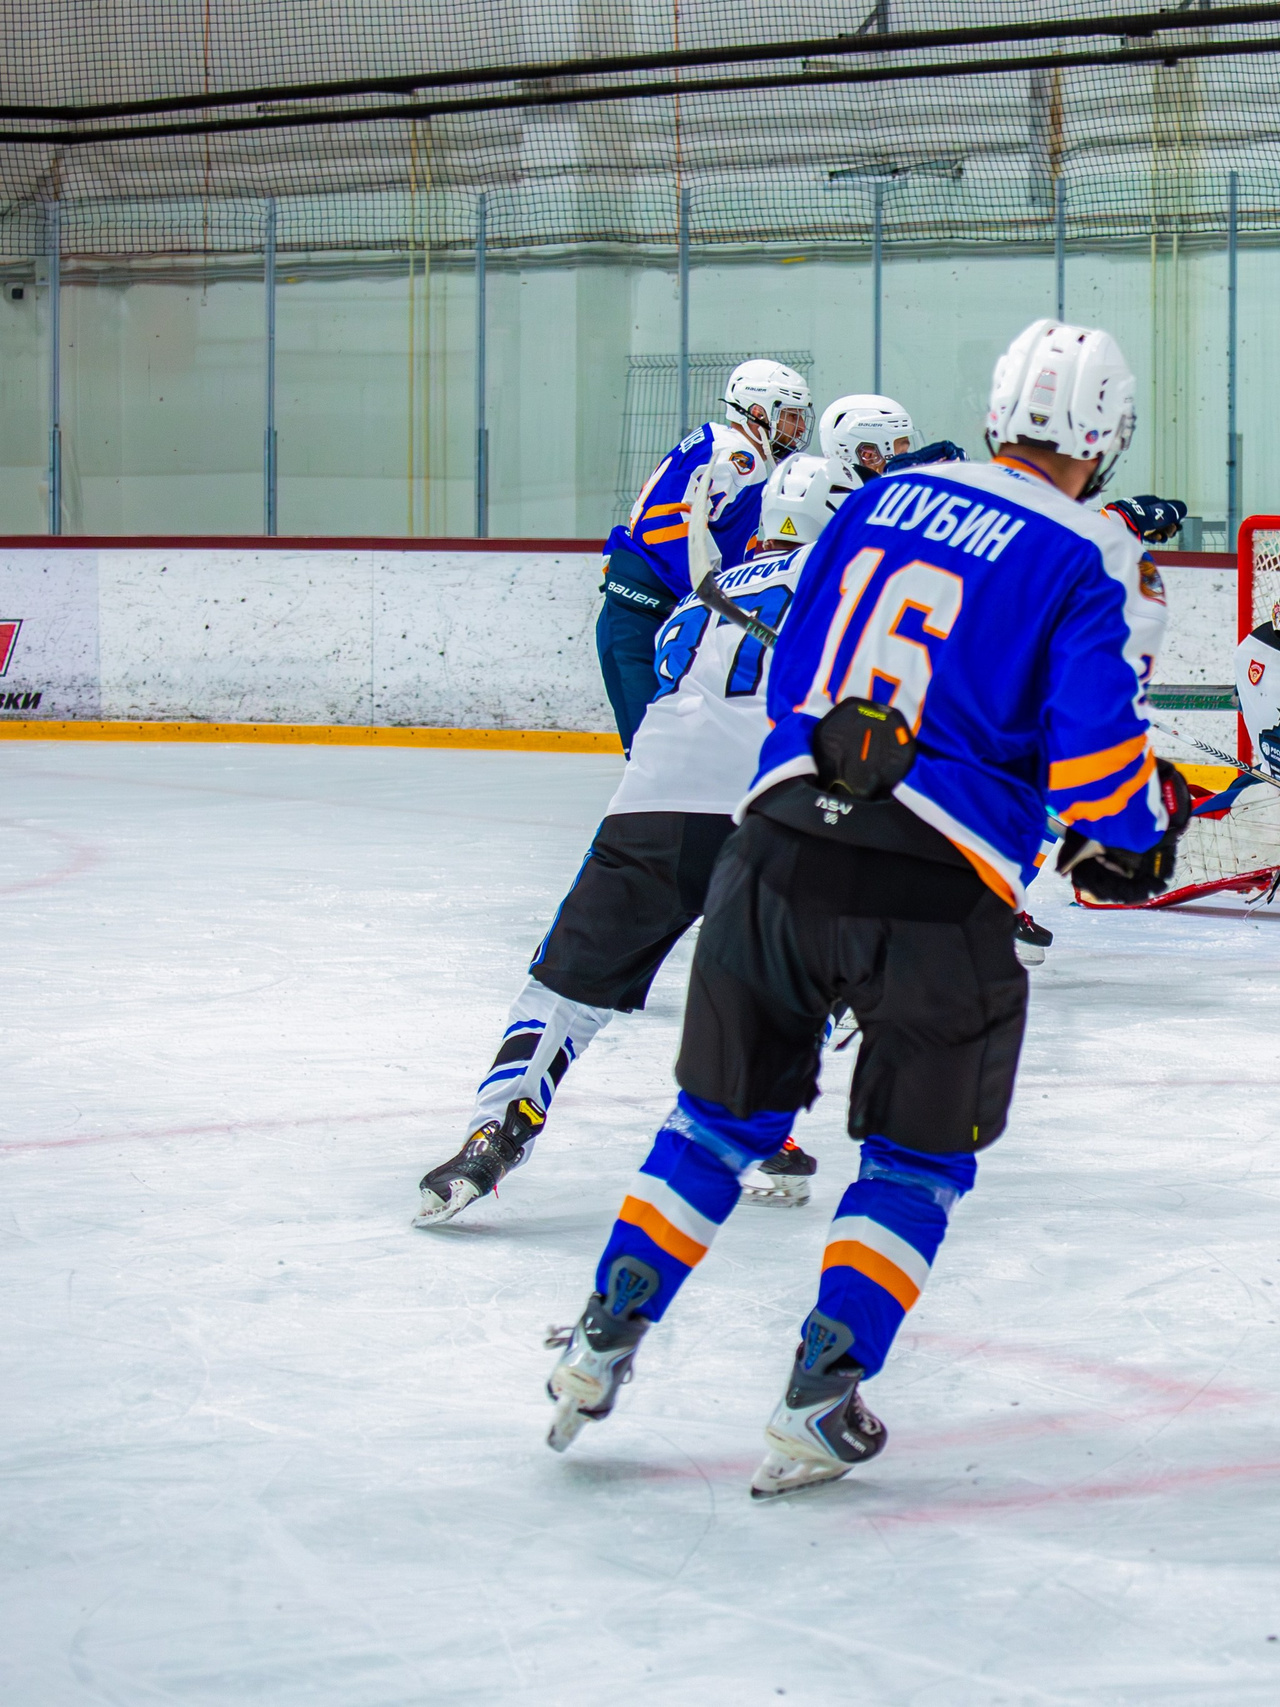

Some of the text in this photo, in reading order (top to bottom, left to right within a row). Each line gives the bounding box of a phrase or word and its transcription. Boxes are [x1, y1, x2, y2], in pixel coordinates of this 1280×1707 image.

[866, 482, 1026, 563] ШУБИН
[607, 581, 660, 608] BAUER
[794, 546, 964, 738] 16
